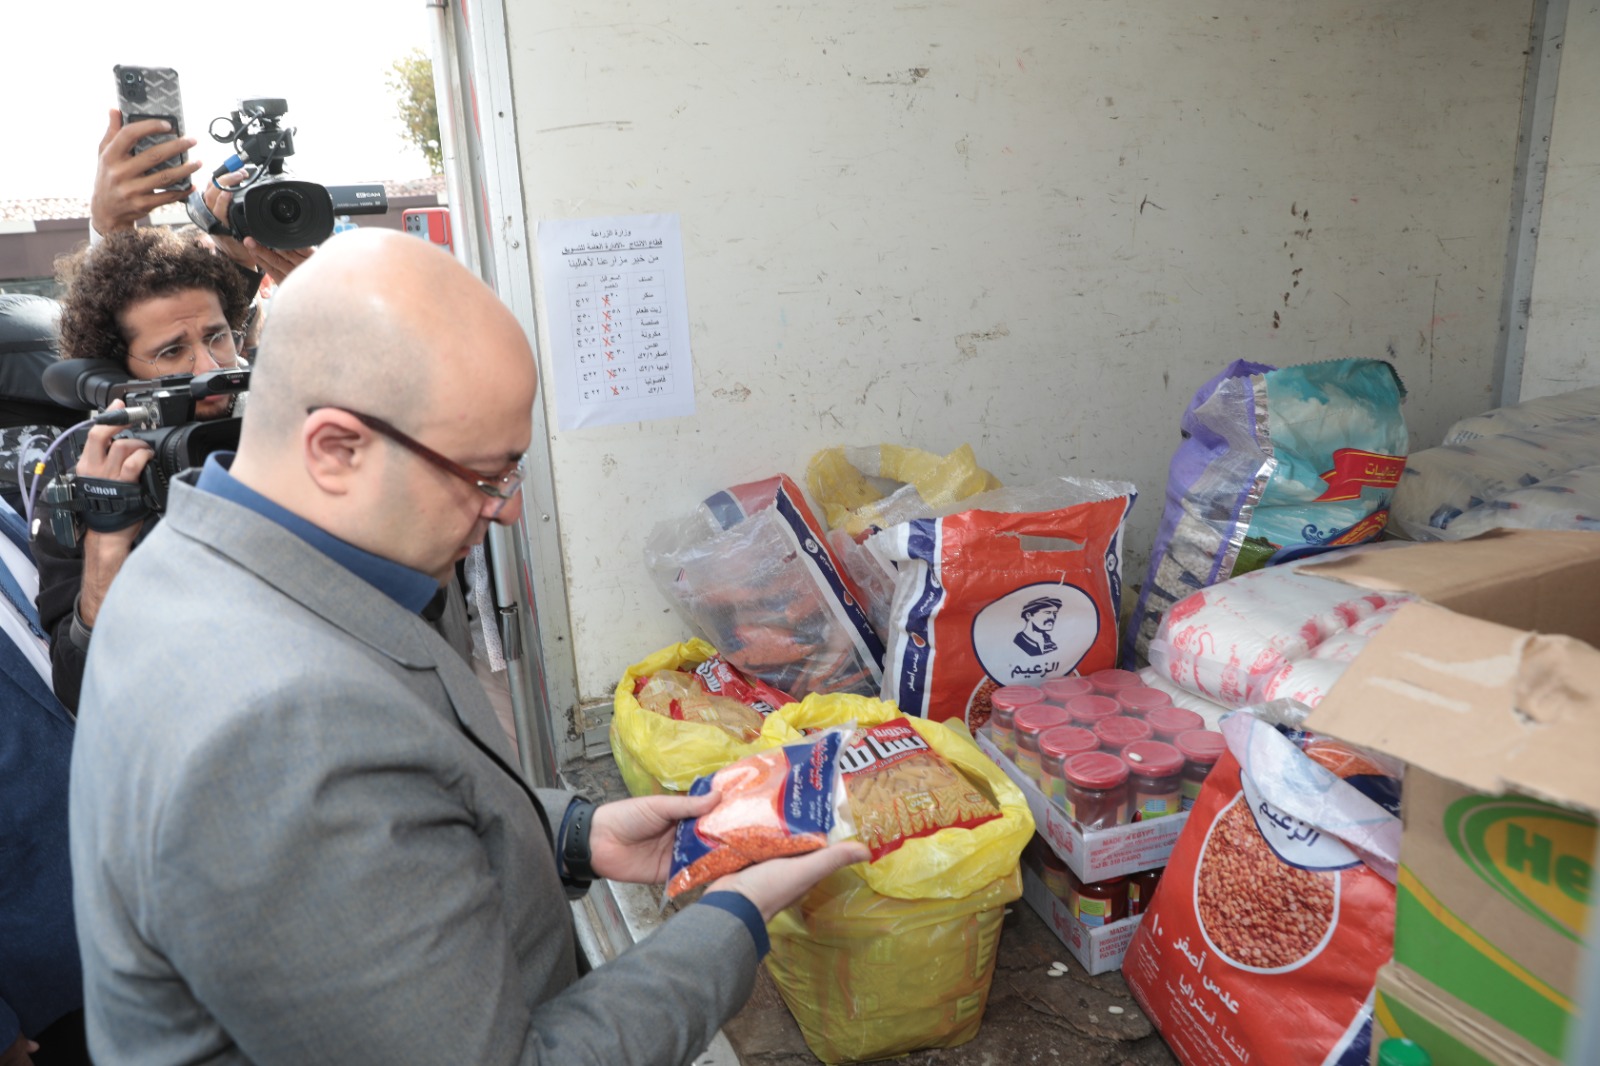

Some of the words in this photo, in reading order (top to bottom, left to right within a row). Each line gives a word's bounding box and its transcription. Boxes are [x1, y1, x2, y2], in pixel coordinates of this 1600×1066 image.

[591, 229, 612, 238] الزراعة
[632, 254, 645, 265] خير
[649, 256, 659, 264] من
[636, 306, 649, 315] طعام
[83, 483, 118, 496] Canon
[1011, 662, 1059, 678] الزعيم
[873, 726, 912, 739] مكرونة
[1260, 802, 1320, 847] الزعيم
[1102, 836, 1121, 846] MADE
[1131, 829, 1155, 839] EGYPT
[1121, 853, 1141, 863] CAIRO
[1109, 926, 1128, 936] MADE
[1173, 936, 1206, 973] أصفر
[1203, 976, 1239, 1014] عدس
